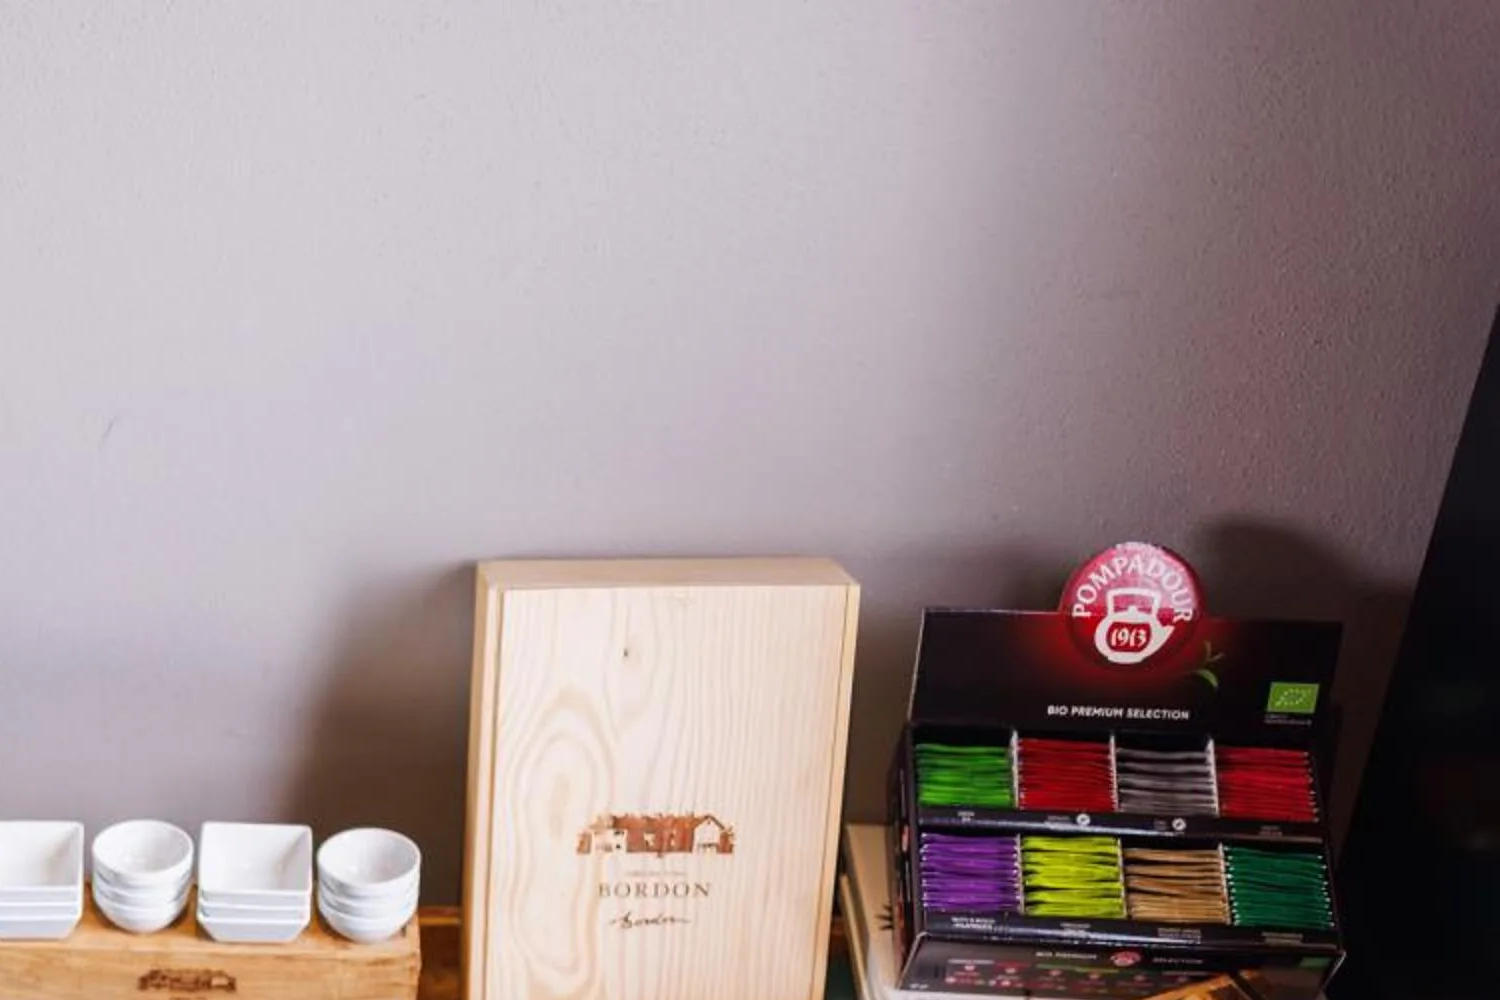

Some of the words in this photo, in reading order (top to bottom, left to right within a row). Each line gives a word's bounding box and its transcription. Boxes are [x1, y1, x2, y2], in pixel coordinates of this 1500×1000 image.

[1072, 554, 1193, 623] POMPADOUR
[1111, 627, 1147, 648] 1913
[1047, 705, 1069, 716] BIO
[1071, 706, 1123, 718] PREMIUM
[1126, 708, 1189, 720] SELECTION
[598, 882, 711, 897] BORDON
